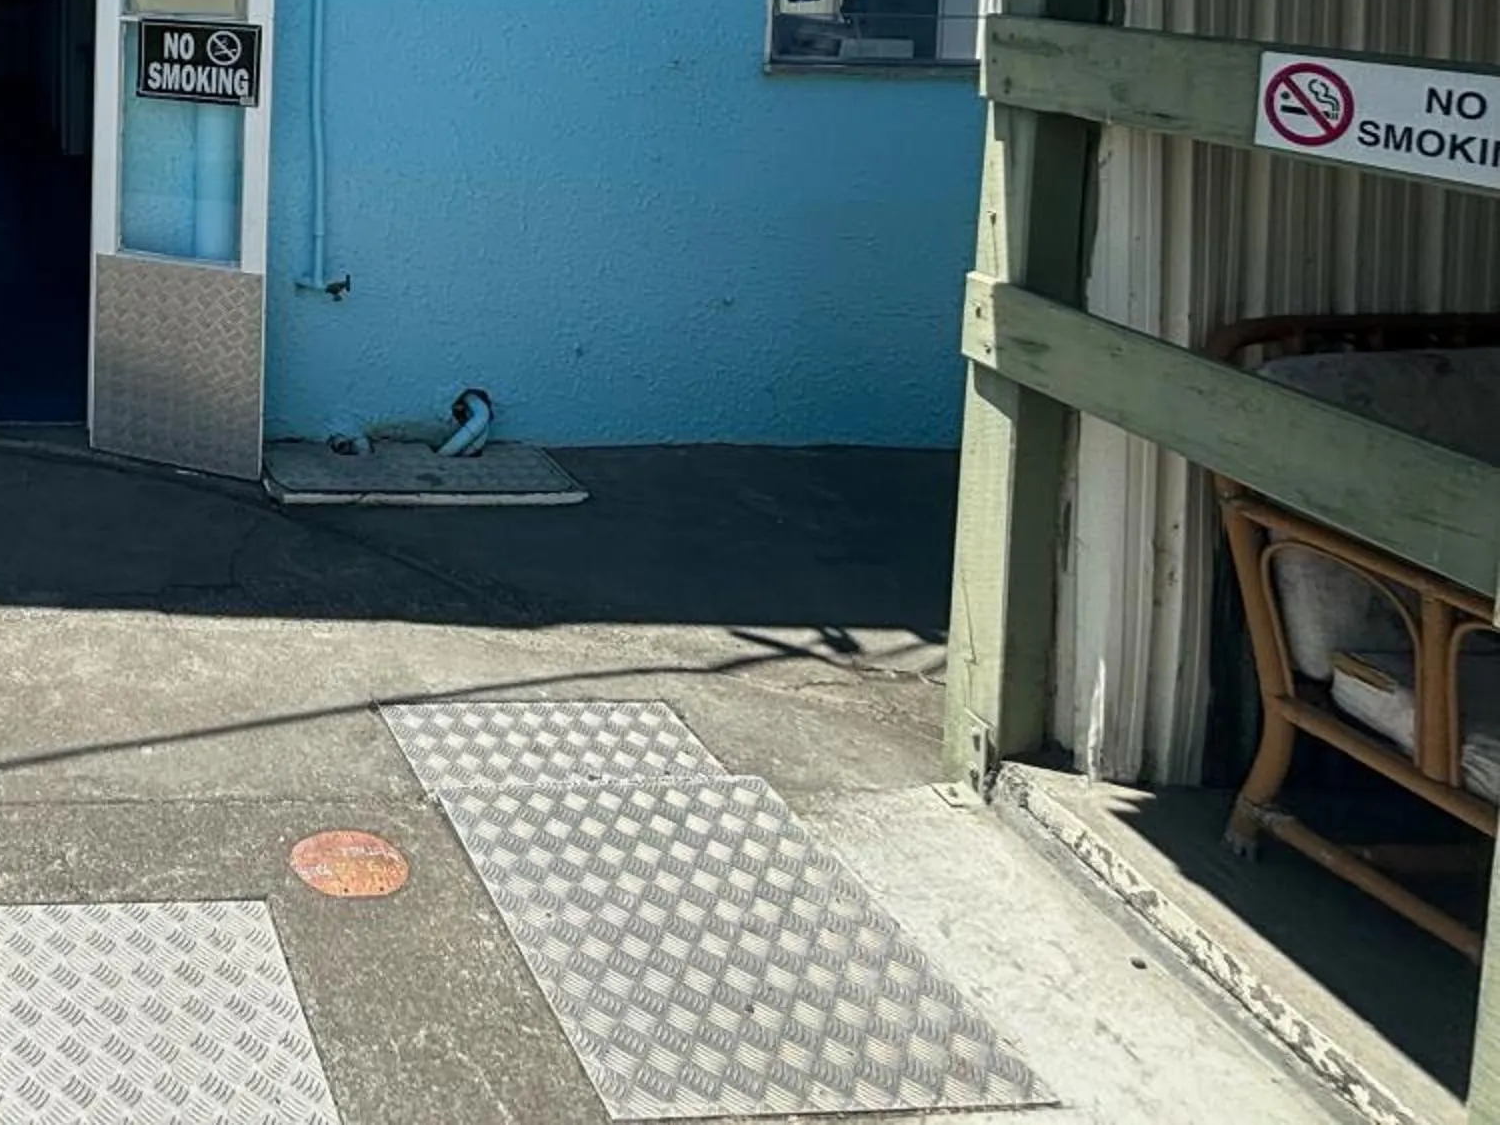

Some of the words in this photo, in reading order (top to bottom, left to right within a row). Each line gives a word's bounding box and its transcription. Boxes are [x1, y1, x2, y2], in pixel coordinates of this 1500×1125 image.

[164, 31, 195, 60] NO
[147, 62, 250, 97] SMOKING
[1425, 86, 1488, 120] NO
